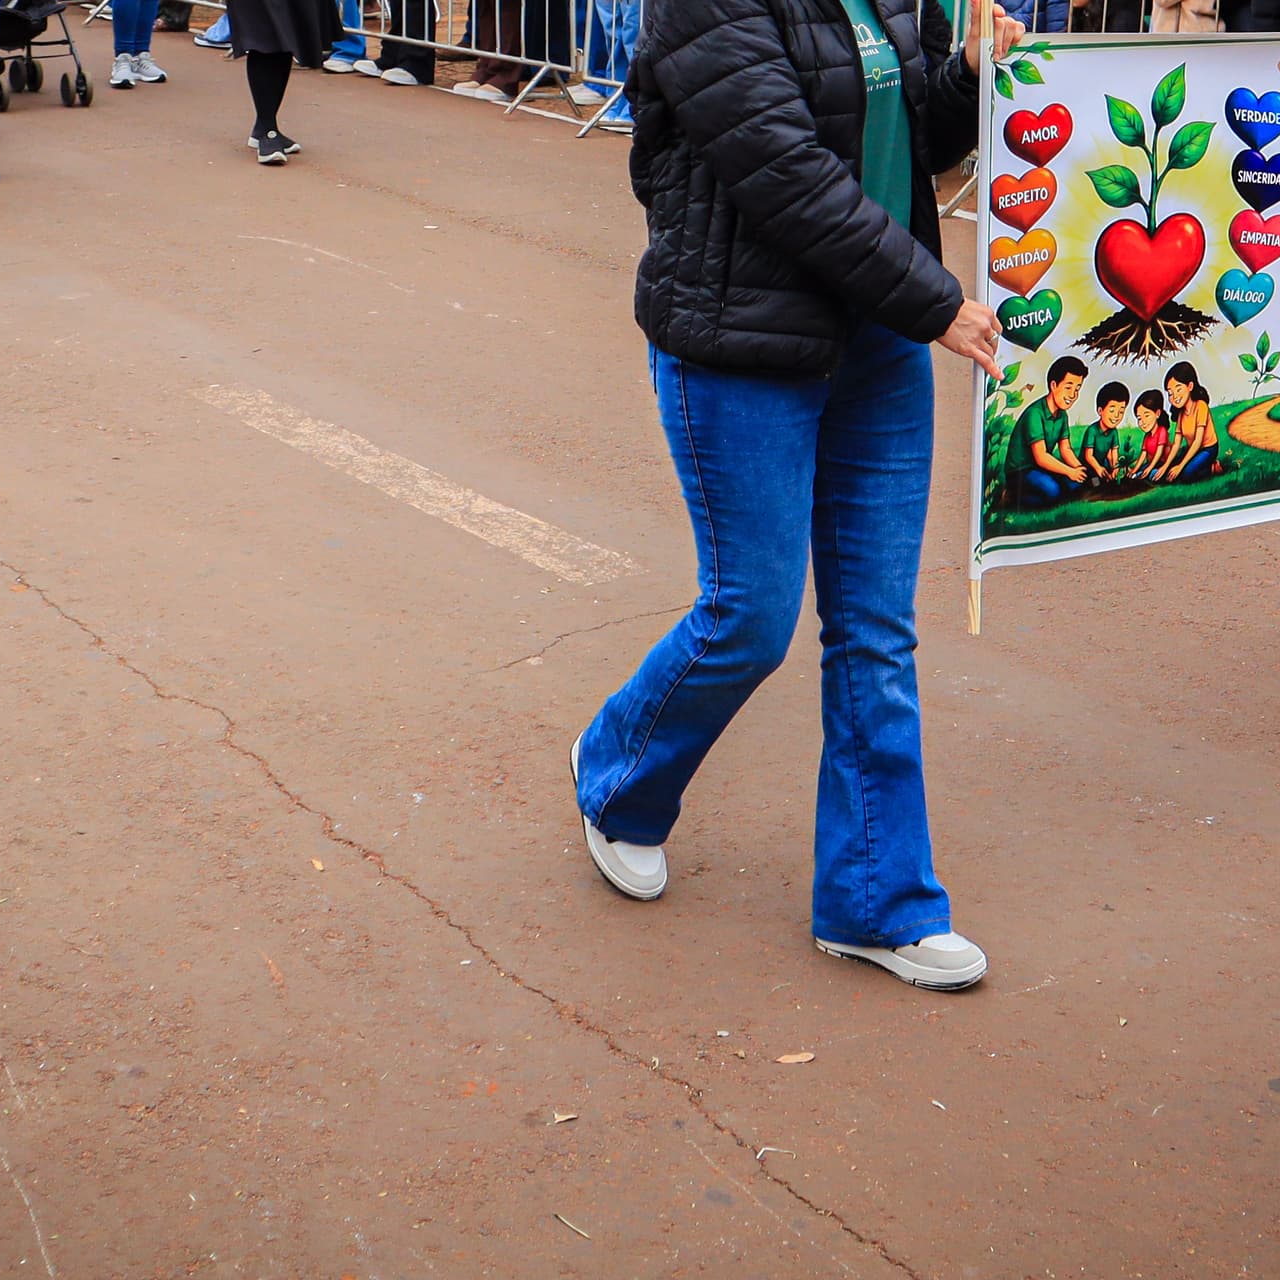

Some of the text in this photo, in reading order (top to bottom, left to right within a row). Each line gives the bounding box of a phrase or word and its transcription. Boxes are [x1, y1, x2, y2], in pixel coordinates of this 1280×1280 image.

[1021, 125, 1059, 145] AMOR
[998, 186, 1049, 210] RESPEITO
[1240, 230, 1280, 247] EMPATIA
[992, 248, 1050, 273] GRATIDÃO
[1222, 287, 1265, 303] DIÁLOGO
[1007, 308, 1053, 331] JUSTIÇA
